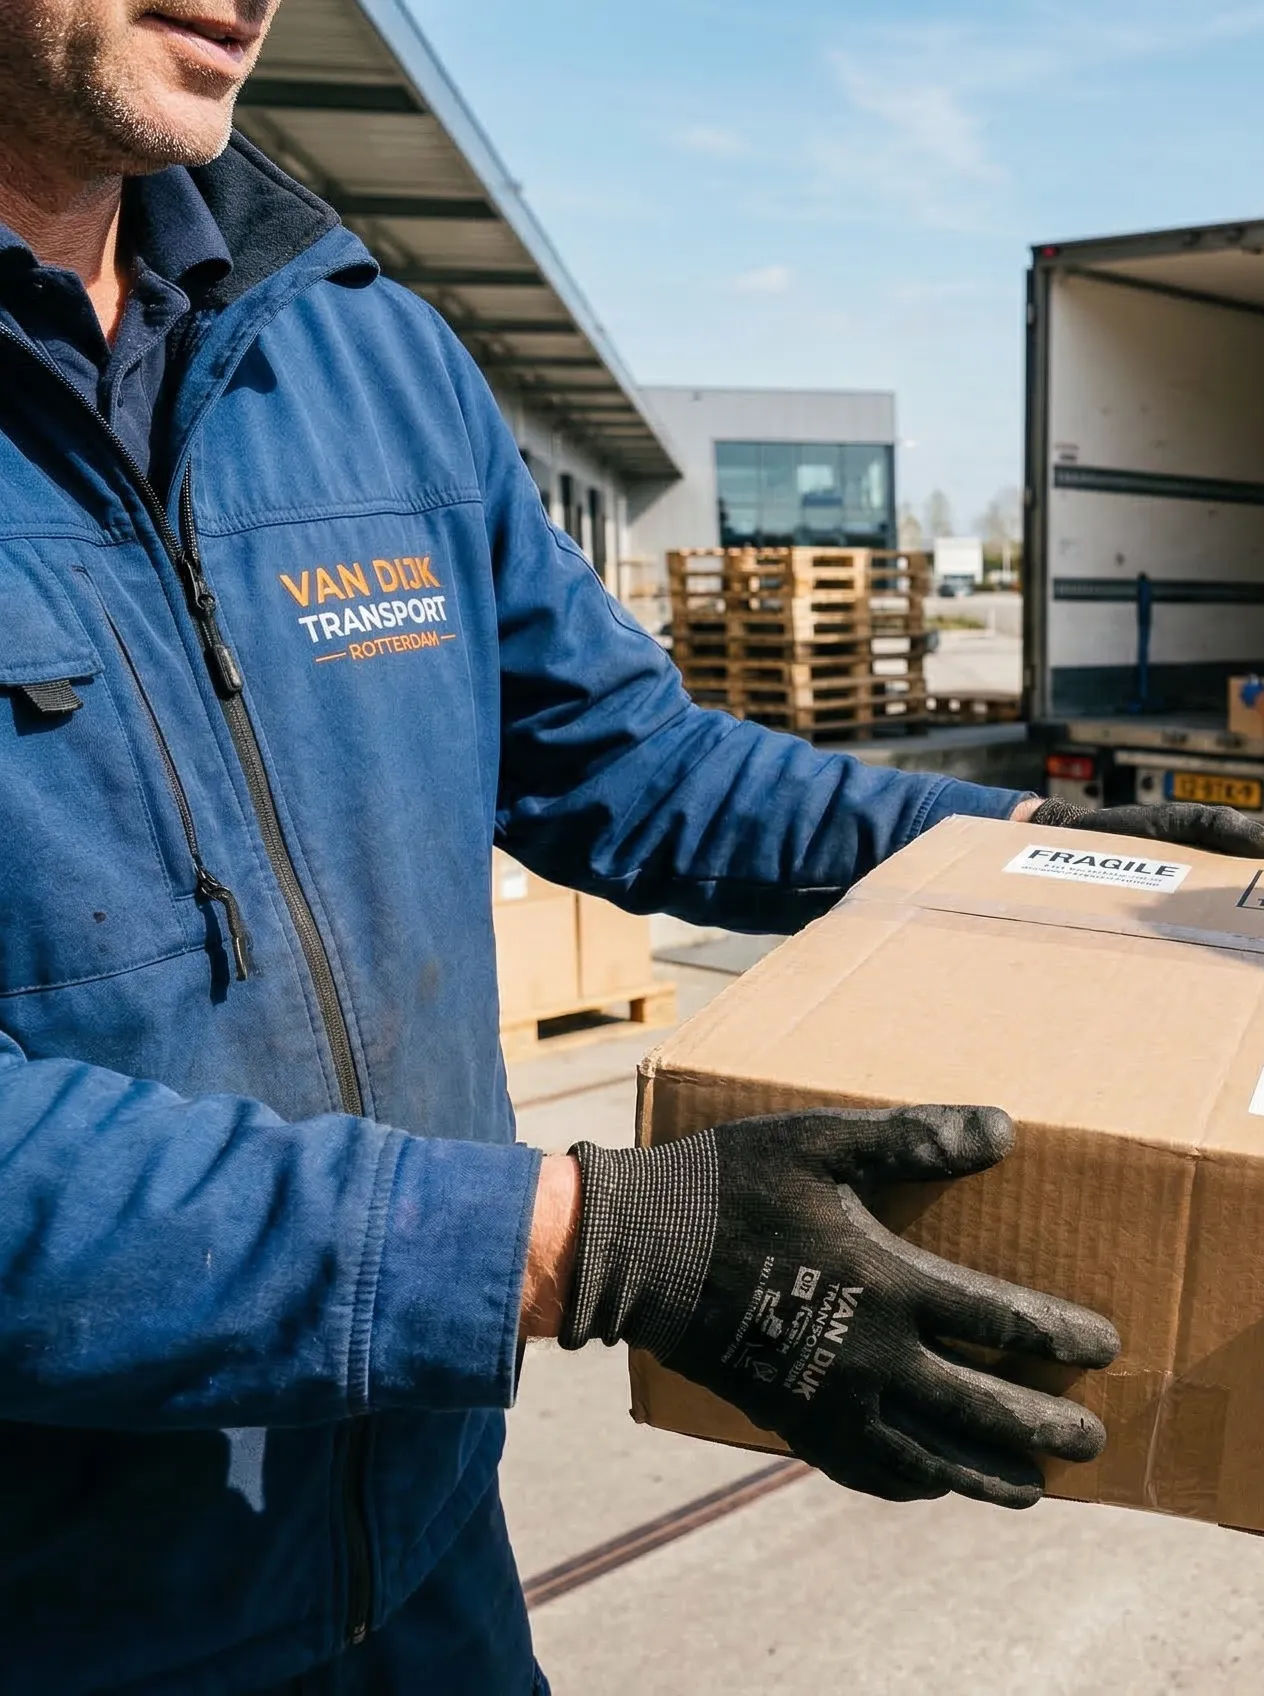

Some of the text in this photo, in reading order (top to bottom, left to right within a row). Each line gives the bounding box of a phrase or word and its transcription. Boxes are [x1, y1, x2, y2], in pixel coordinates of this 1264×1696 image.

[280, 556, 441, 608] VAN DIJK
[298, 595, 447, 643] TRANSPORT
[349, 630, 440, 660] ROTTERDAM
[1028, 848, 1180, 877] FRAGILE
[824, 1287, 864, 1344] VAN
[792, 1347, 836, 1401] DIJK
